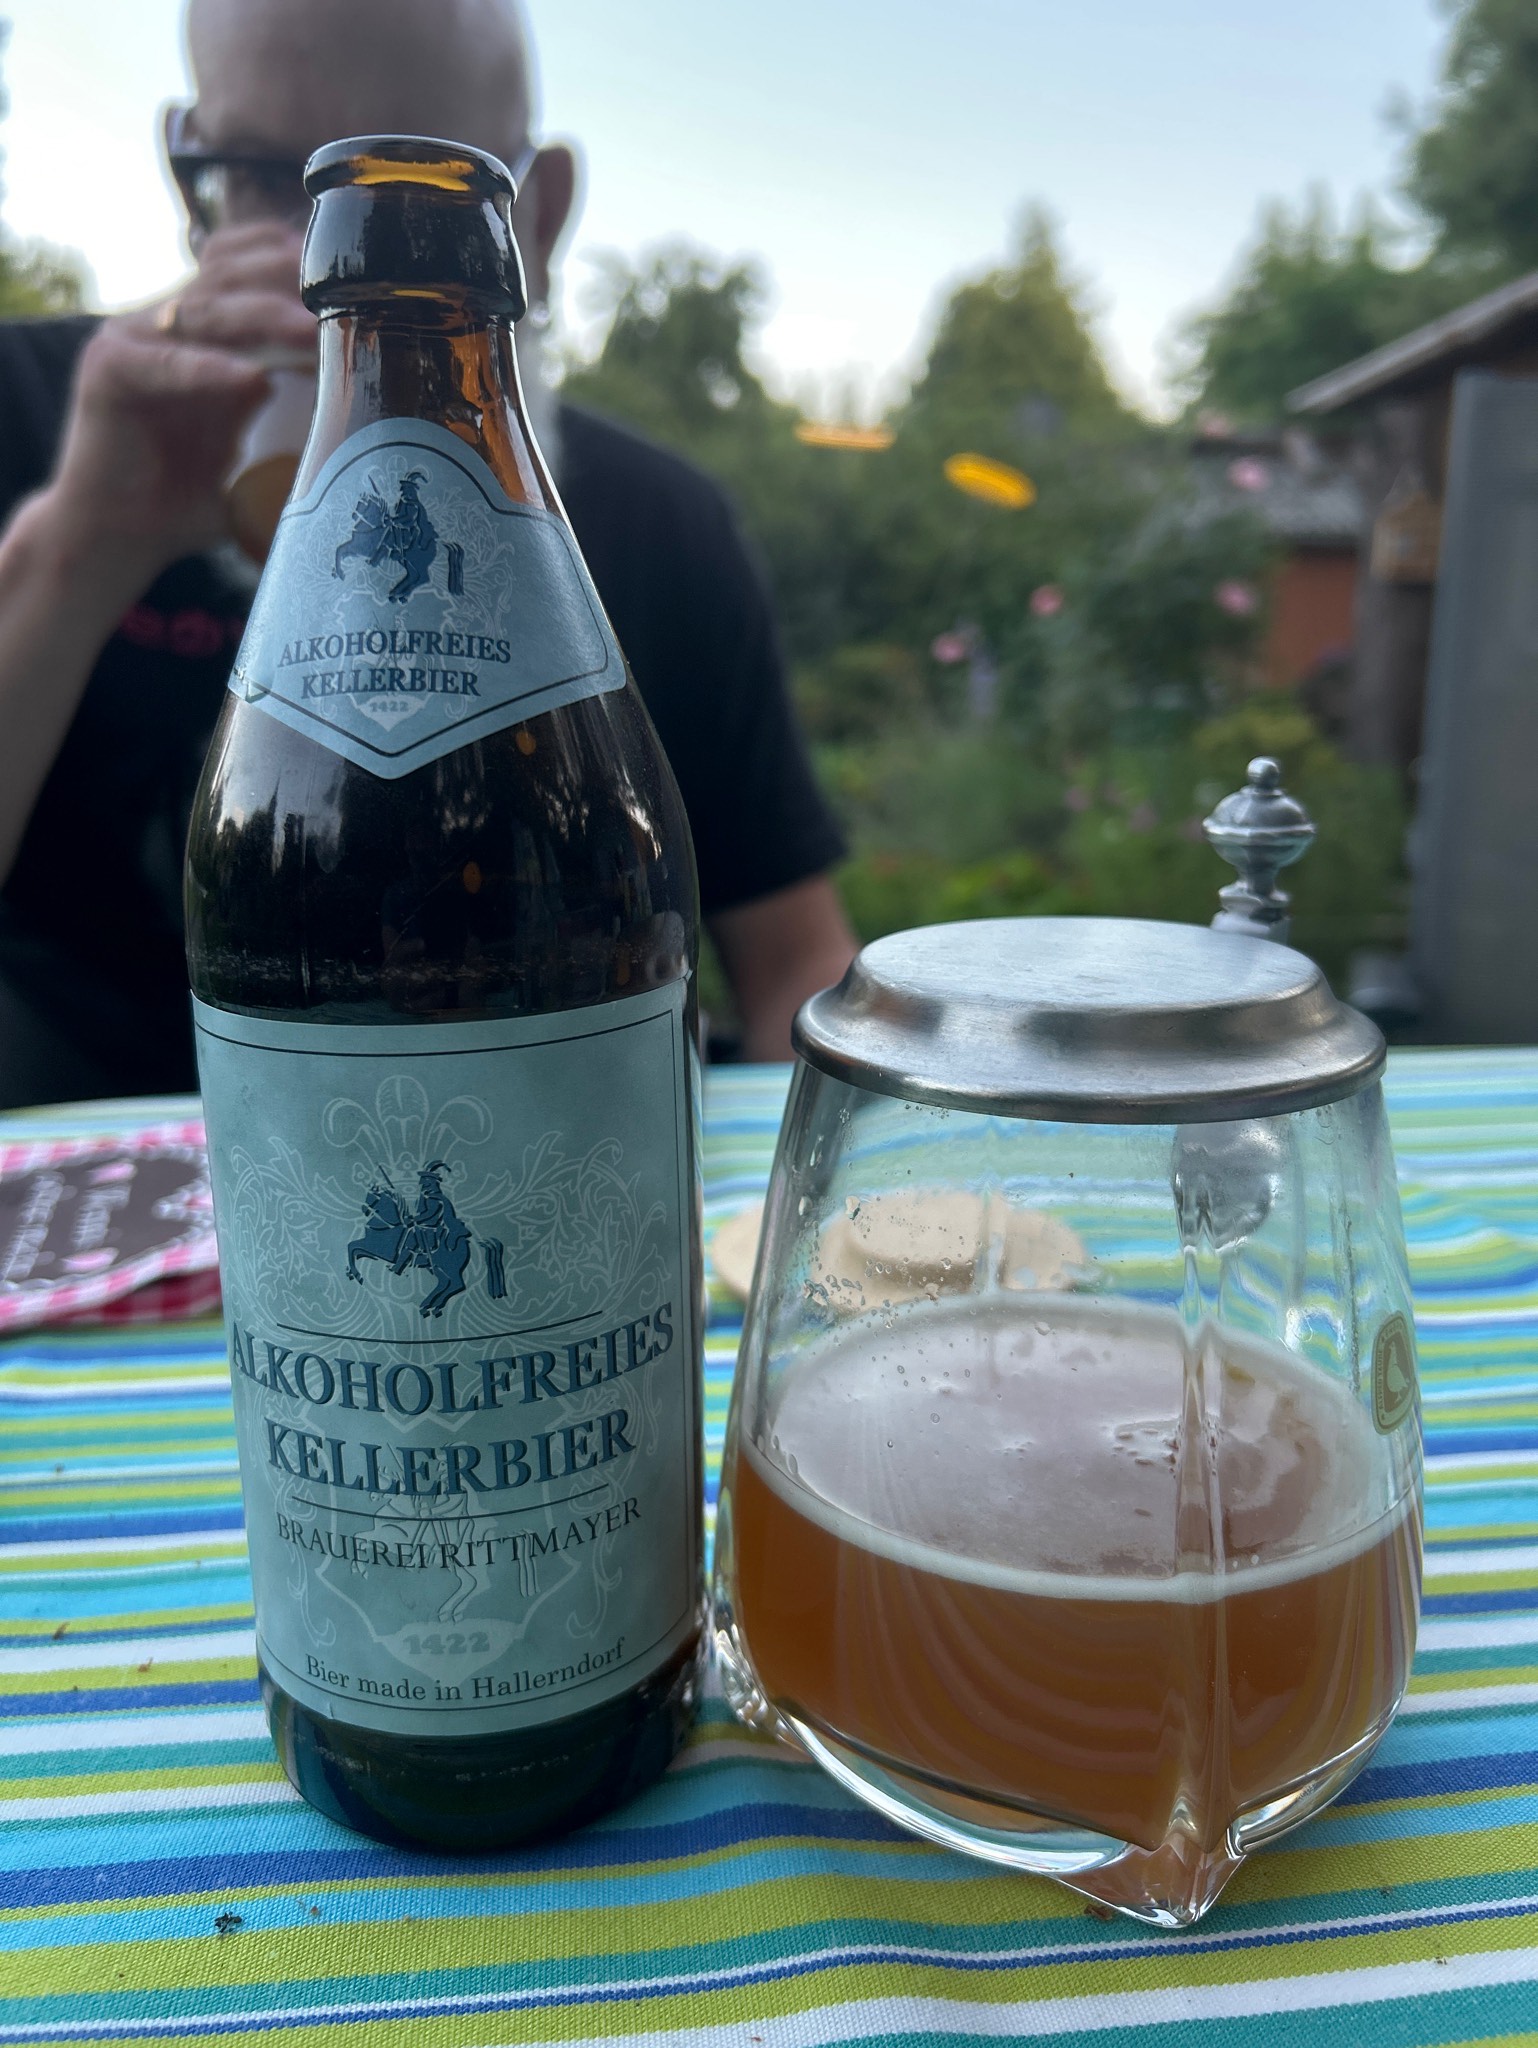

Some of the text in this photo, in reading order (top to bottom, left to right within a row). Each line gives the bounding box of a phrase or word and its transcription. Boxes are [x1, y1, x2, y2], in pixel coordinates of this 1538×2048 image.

[277, 630, 511, 668] ALKOHOLFREIES
[301, 668, 481, 699] KELLERBIER
[369, 700, 410, 713] 1422
[231, 1301, 674, 1416] ALKOHOLFREIES
[263, 1407, 637, 1497] KELLERBIER
[276, 1496, 642, 1569] BRAUEREI RITTMAYER
[402, 1629, 490, 1656] 1422
[306, 1636, 627, 1701] Bier made in Hallerndorf
